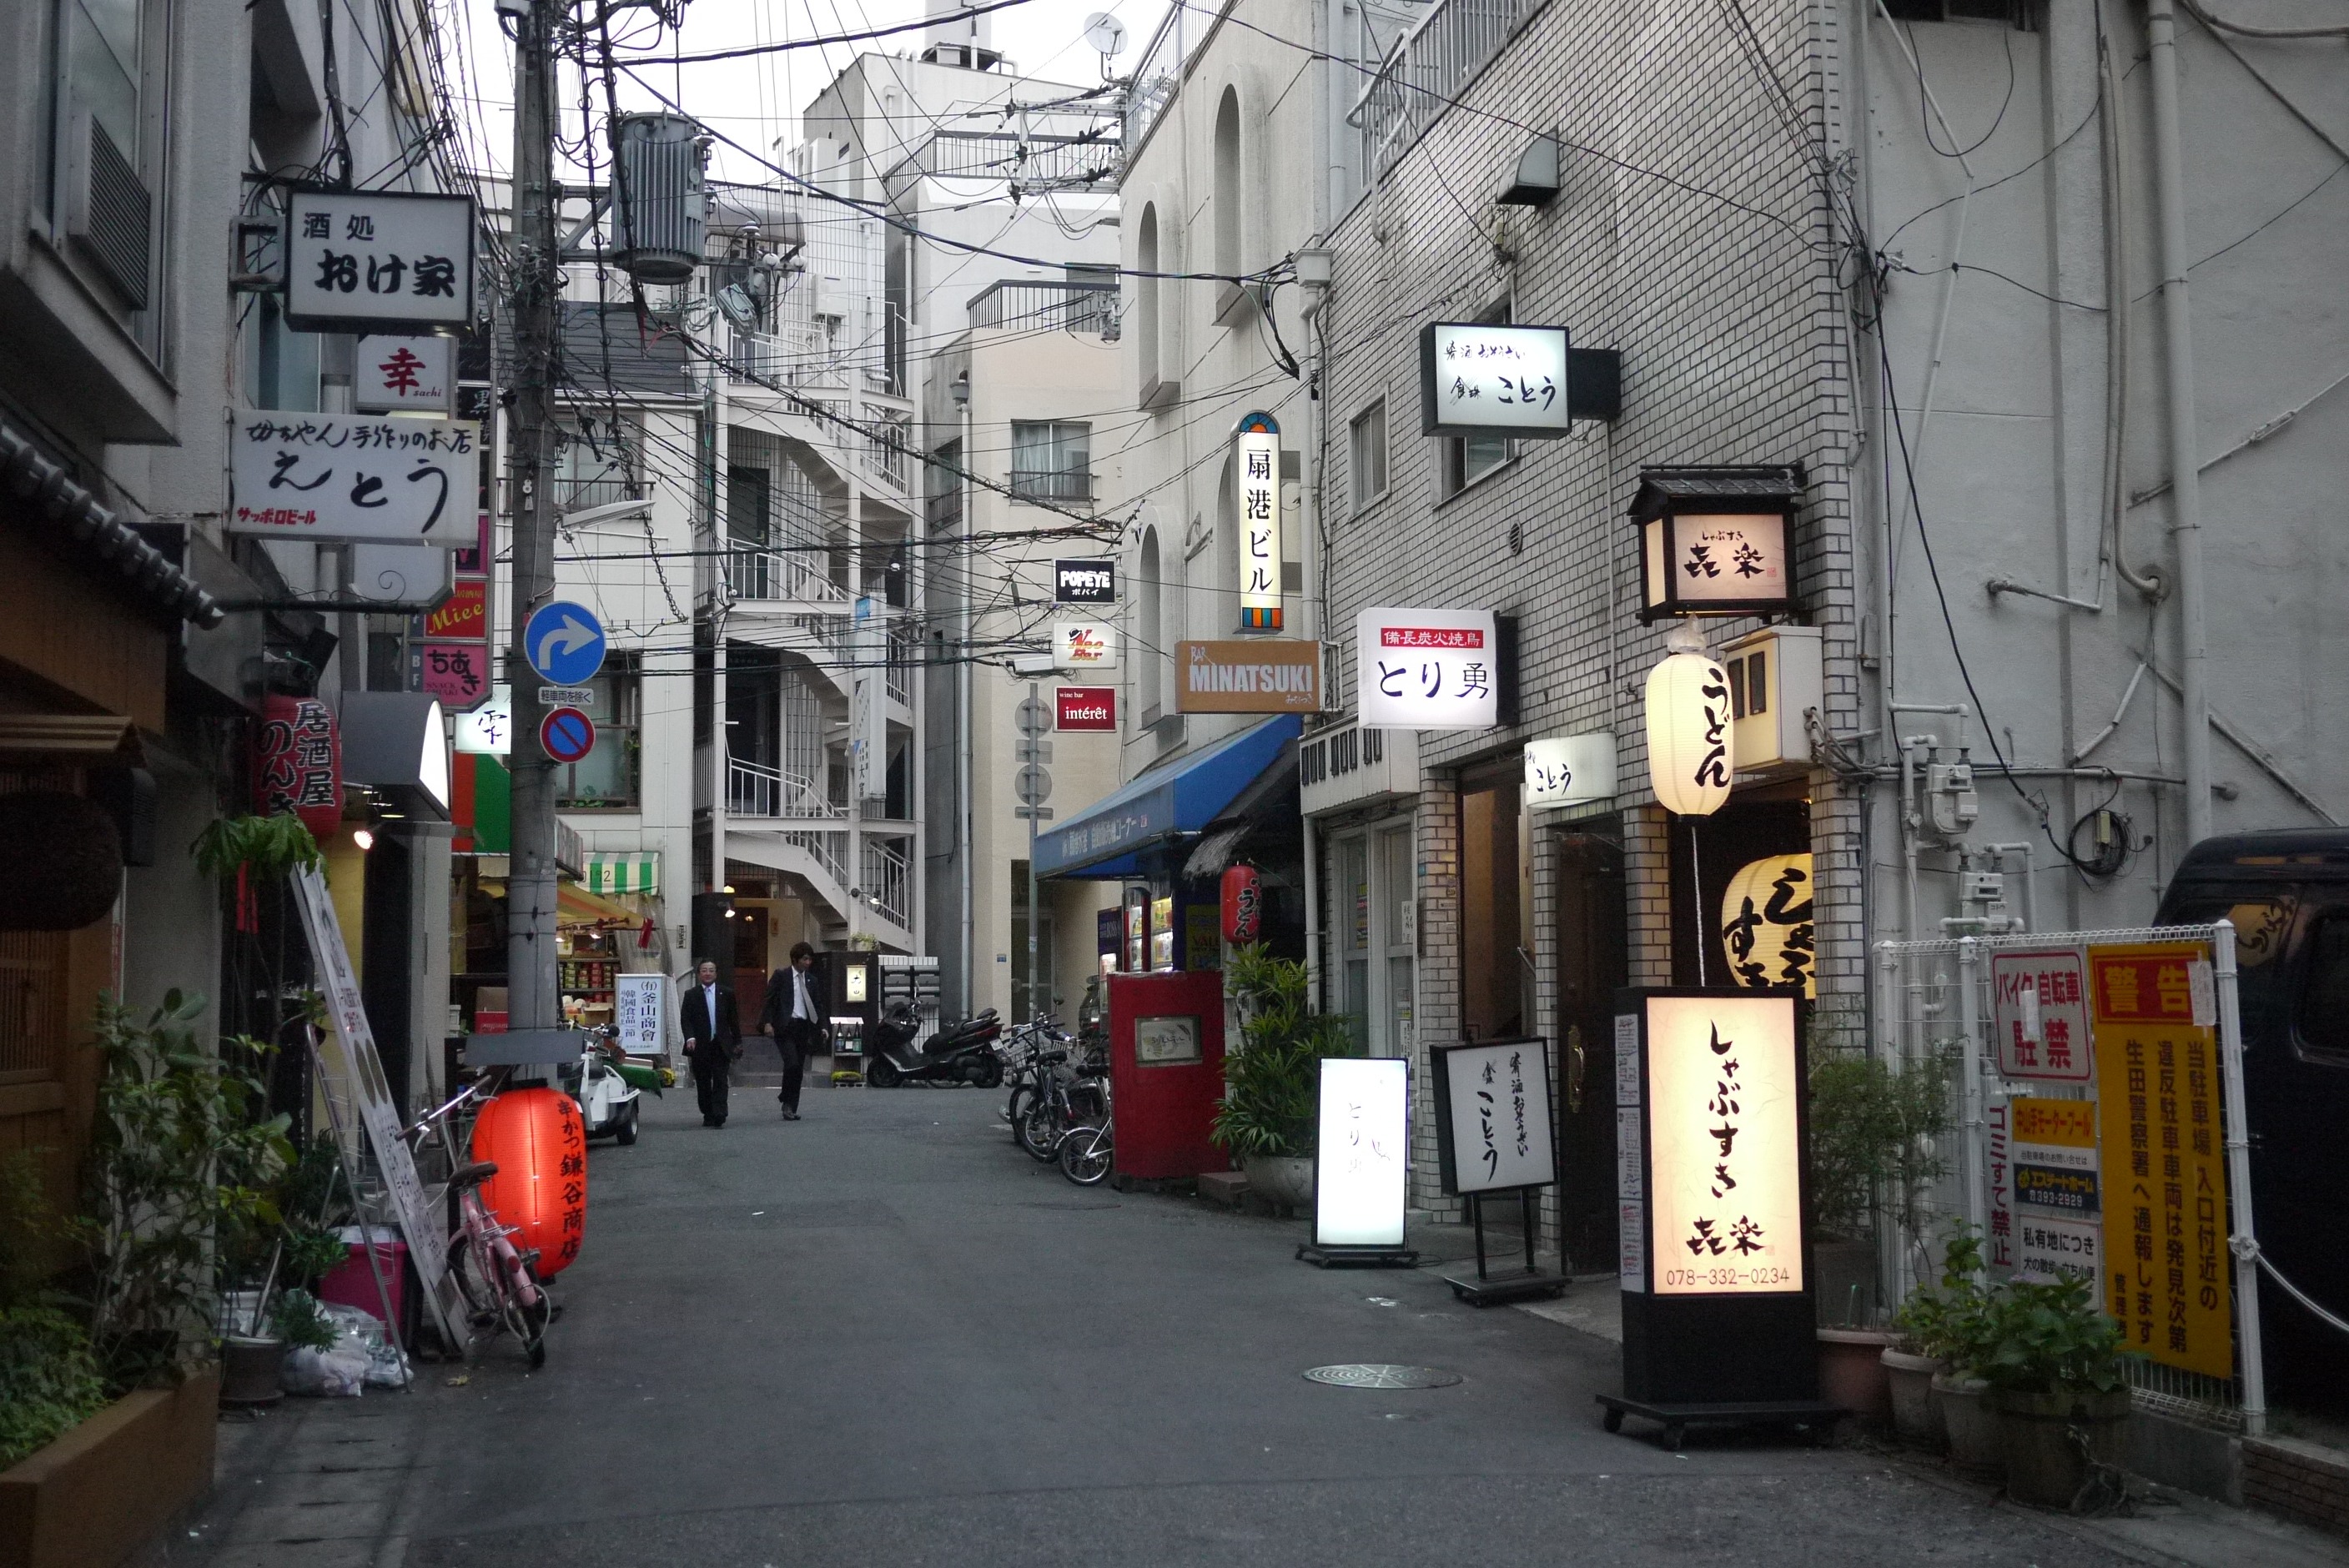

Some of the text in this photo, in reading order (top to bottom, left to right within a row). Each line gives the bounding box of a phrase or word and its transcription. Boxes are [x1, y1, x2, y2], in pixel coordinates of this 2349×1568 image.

[303, 212, 375, 241] 酒処
[314, 248, 456, 299] おけ家
[378, 346, 426, 397] 幸
[412, 388, 442, 399] sachi
[268, 450, 449, 535] えとう
[237, 506, 317, 525] サッポロビール
[1246, 447, 1275, 594] 扇港ビル
[1701, 529, 1744, 542] しゃぶすき
[1059, 570, 1111, 589] POPEYE
[1071, 587, 1100, 596] ポパイ
[428, 603, 485, 635] Miee
[1383, 630, 1481, 647] 備長炭火焼鳥
[1190, 646, 1207, 665] BAR
[426, 649, 481, 697] ちあき
[1189, 664, 1313, 693] MINATSUKI
[1377, 660, 1490, 700] とり勇
[541, 689, 591, 704] 軽車両を除く
[1064, 704, 1108, 721] intérêt
[1693, 666, 1732, 788] うどん
[293, 701, 335, 807] 居酒屋
[1234, 887, 1257, 938] うどん
[2104, 965, 2191, 1013] 警告
[1708, 1018, 1742, 1199] しゃぶすき
[1989, 1105, 2013, 1267] ゴミすて禁止
[2023, 1227, 2095, 1256] 私有地につき
[1666, 1267, 1791, 1287] 078-332-0234
